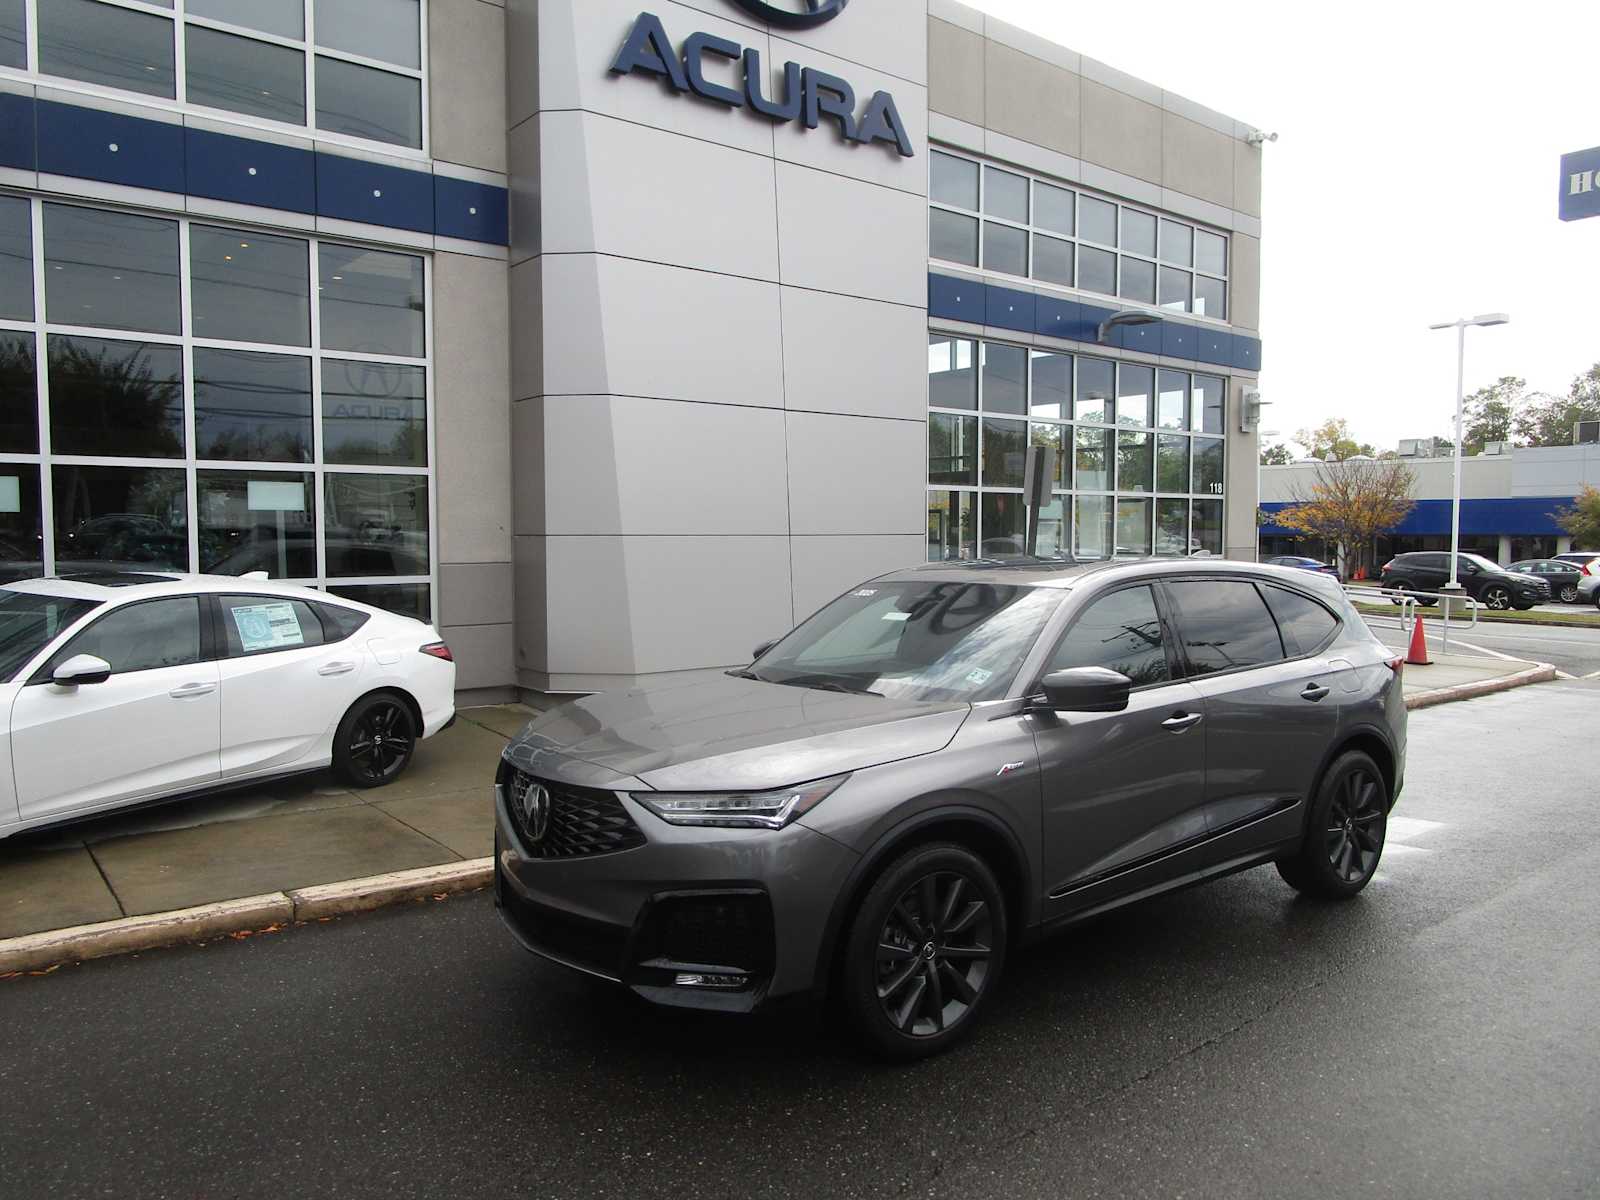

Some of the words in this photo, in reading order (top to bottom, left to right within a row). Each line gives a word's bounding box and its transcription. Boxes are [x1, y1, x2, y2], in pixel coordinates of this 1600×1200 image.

[609, 11, 914, 157] ACURA
[1568, 170, 1600, 195] H
[1209, 482, 1223, 494] 118
